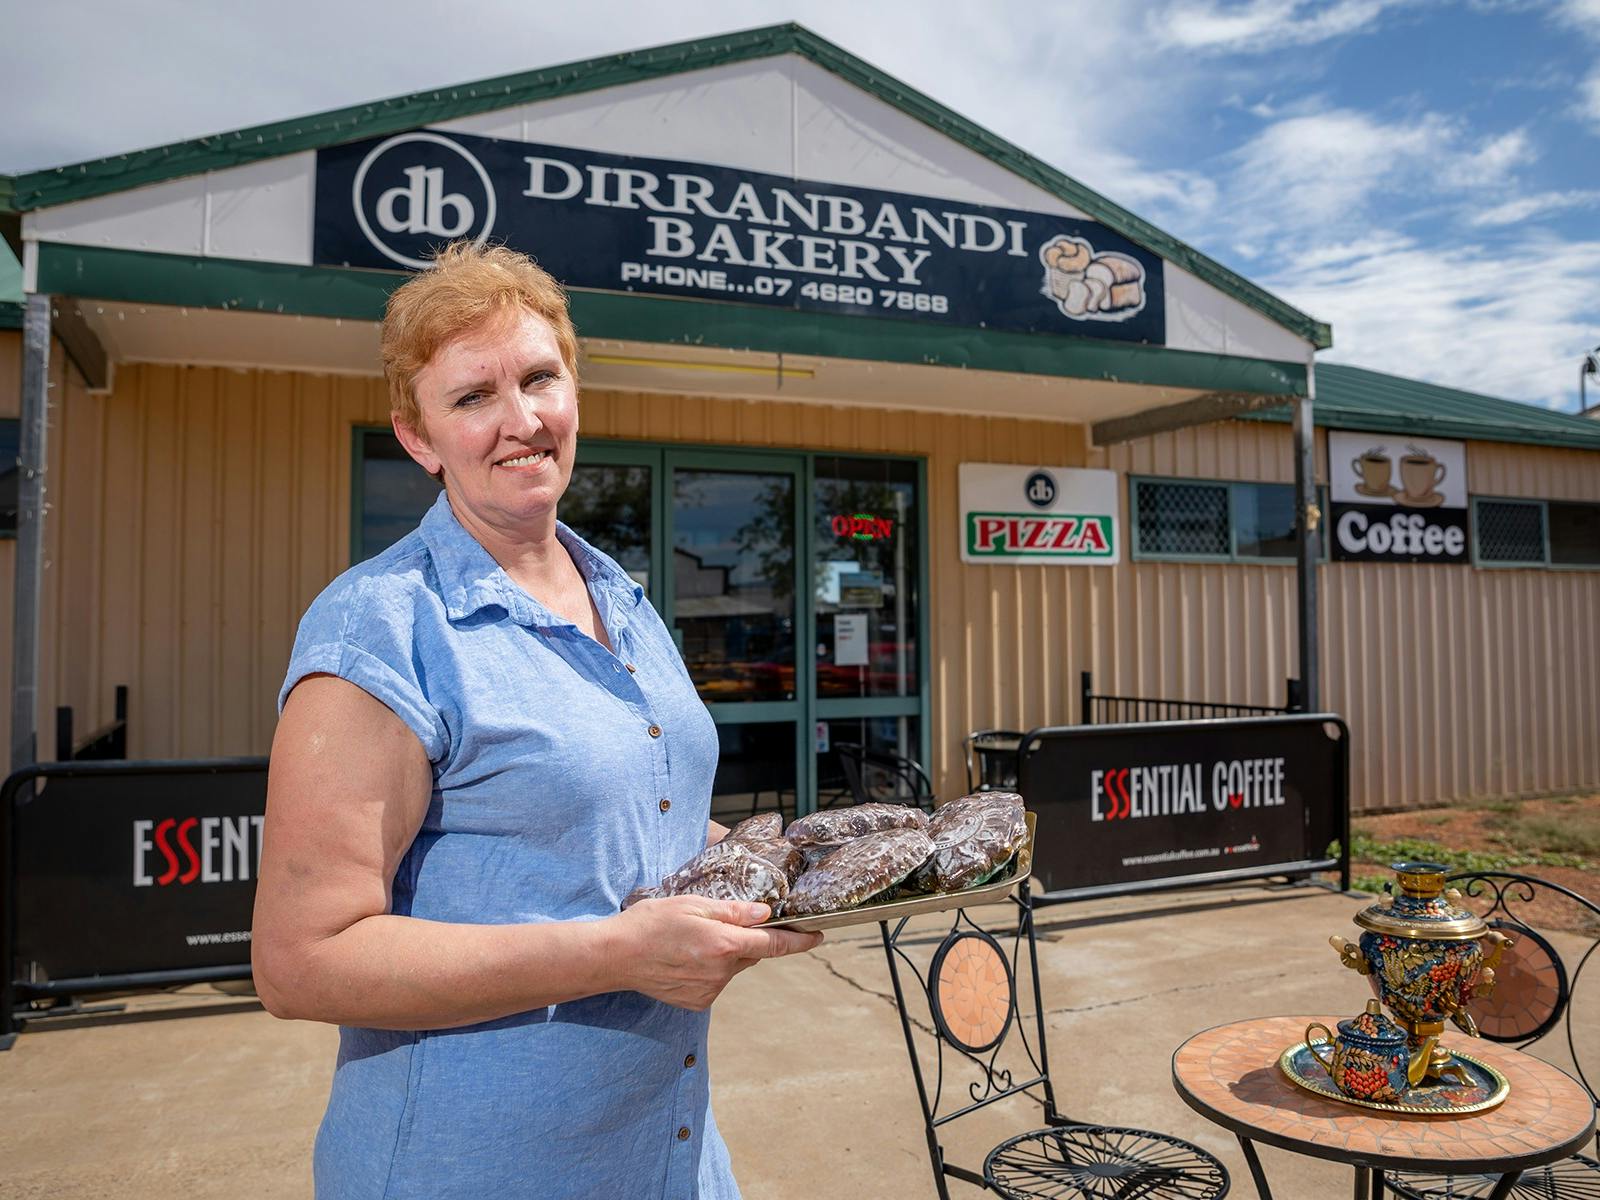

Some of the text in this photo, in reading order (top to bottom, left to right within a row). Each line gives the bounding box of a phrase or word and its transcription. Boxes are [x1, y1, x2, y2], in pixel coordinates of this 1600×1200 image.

[376, 164, 475, 238] db
[522, 156, 1028, 257] DIRRANBANDI
[645, 215, 932, 286] BAKERY
[800, 282, 874, 306] 4620
[879, 288, 949, 314] 7868
[831, 514, 893, 540] OPEN
[975, 517, 1106, 551] PIZZA
[1336, 510, 1465, 556] Coffee
[1091, 757, 1285, 822] ESSENTIAL COFFEE
